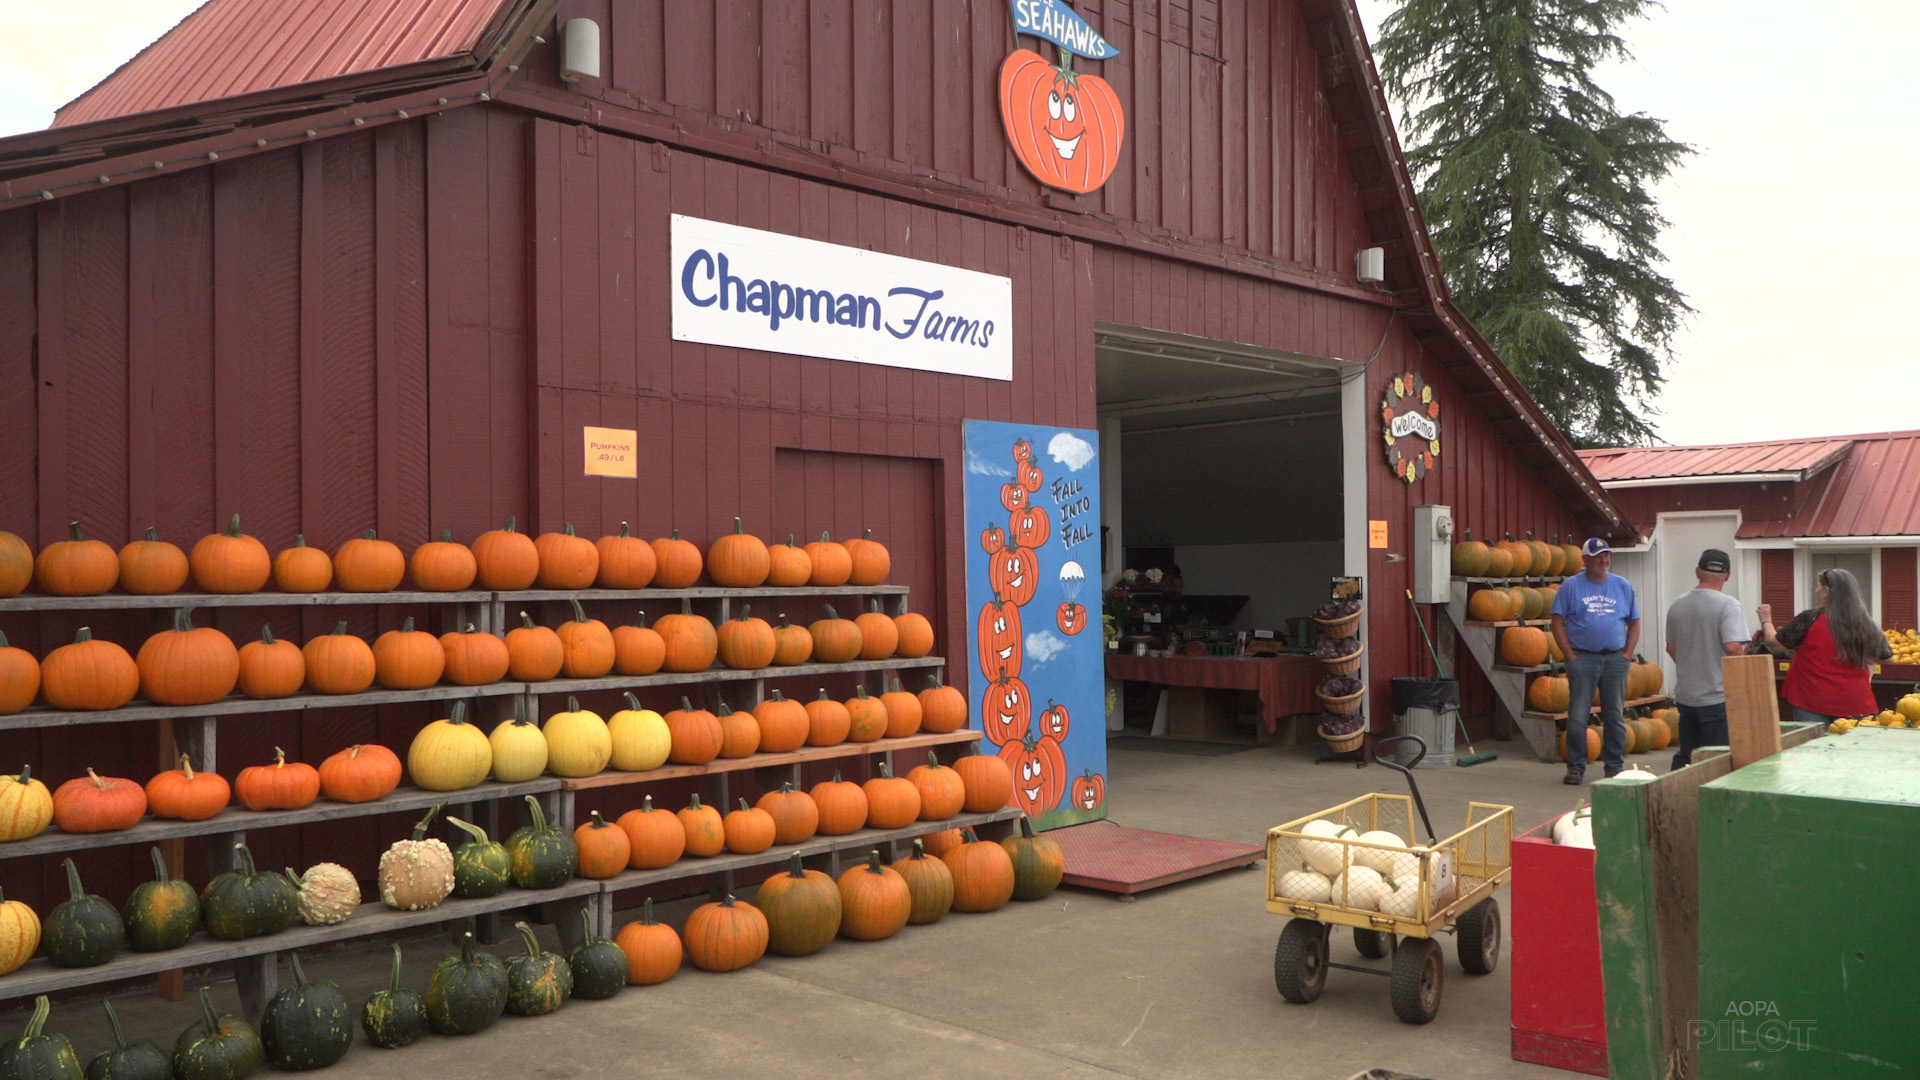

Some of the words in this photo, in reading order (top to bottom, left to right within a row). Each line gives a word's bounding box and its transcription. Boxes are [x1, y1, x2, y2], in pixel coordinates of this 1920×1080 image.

[1016, 1, 1106, 57] SEAHAWKS
[681, 248, 882, 332] Chapman
[884, 286, 994, 348] Farms
[1051, 477, 1083, 505] FALL
[1060, 496, 1090, 525] INTO
[1061, 523, 1093, 550] FALL
[1441, 863, 1447, 878] 8
